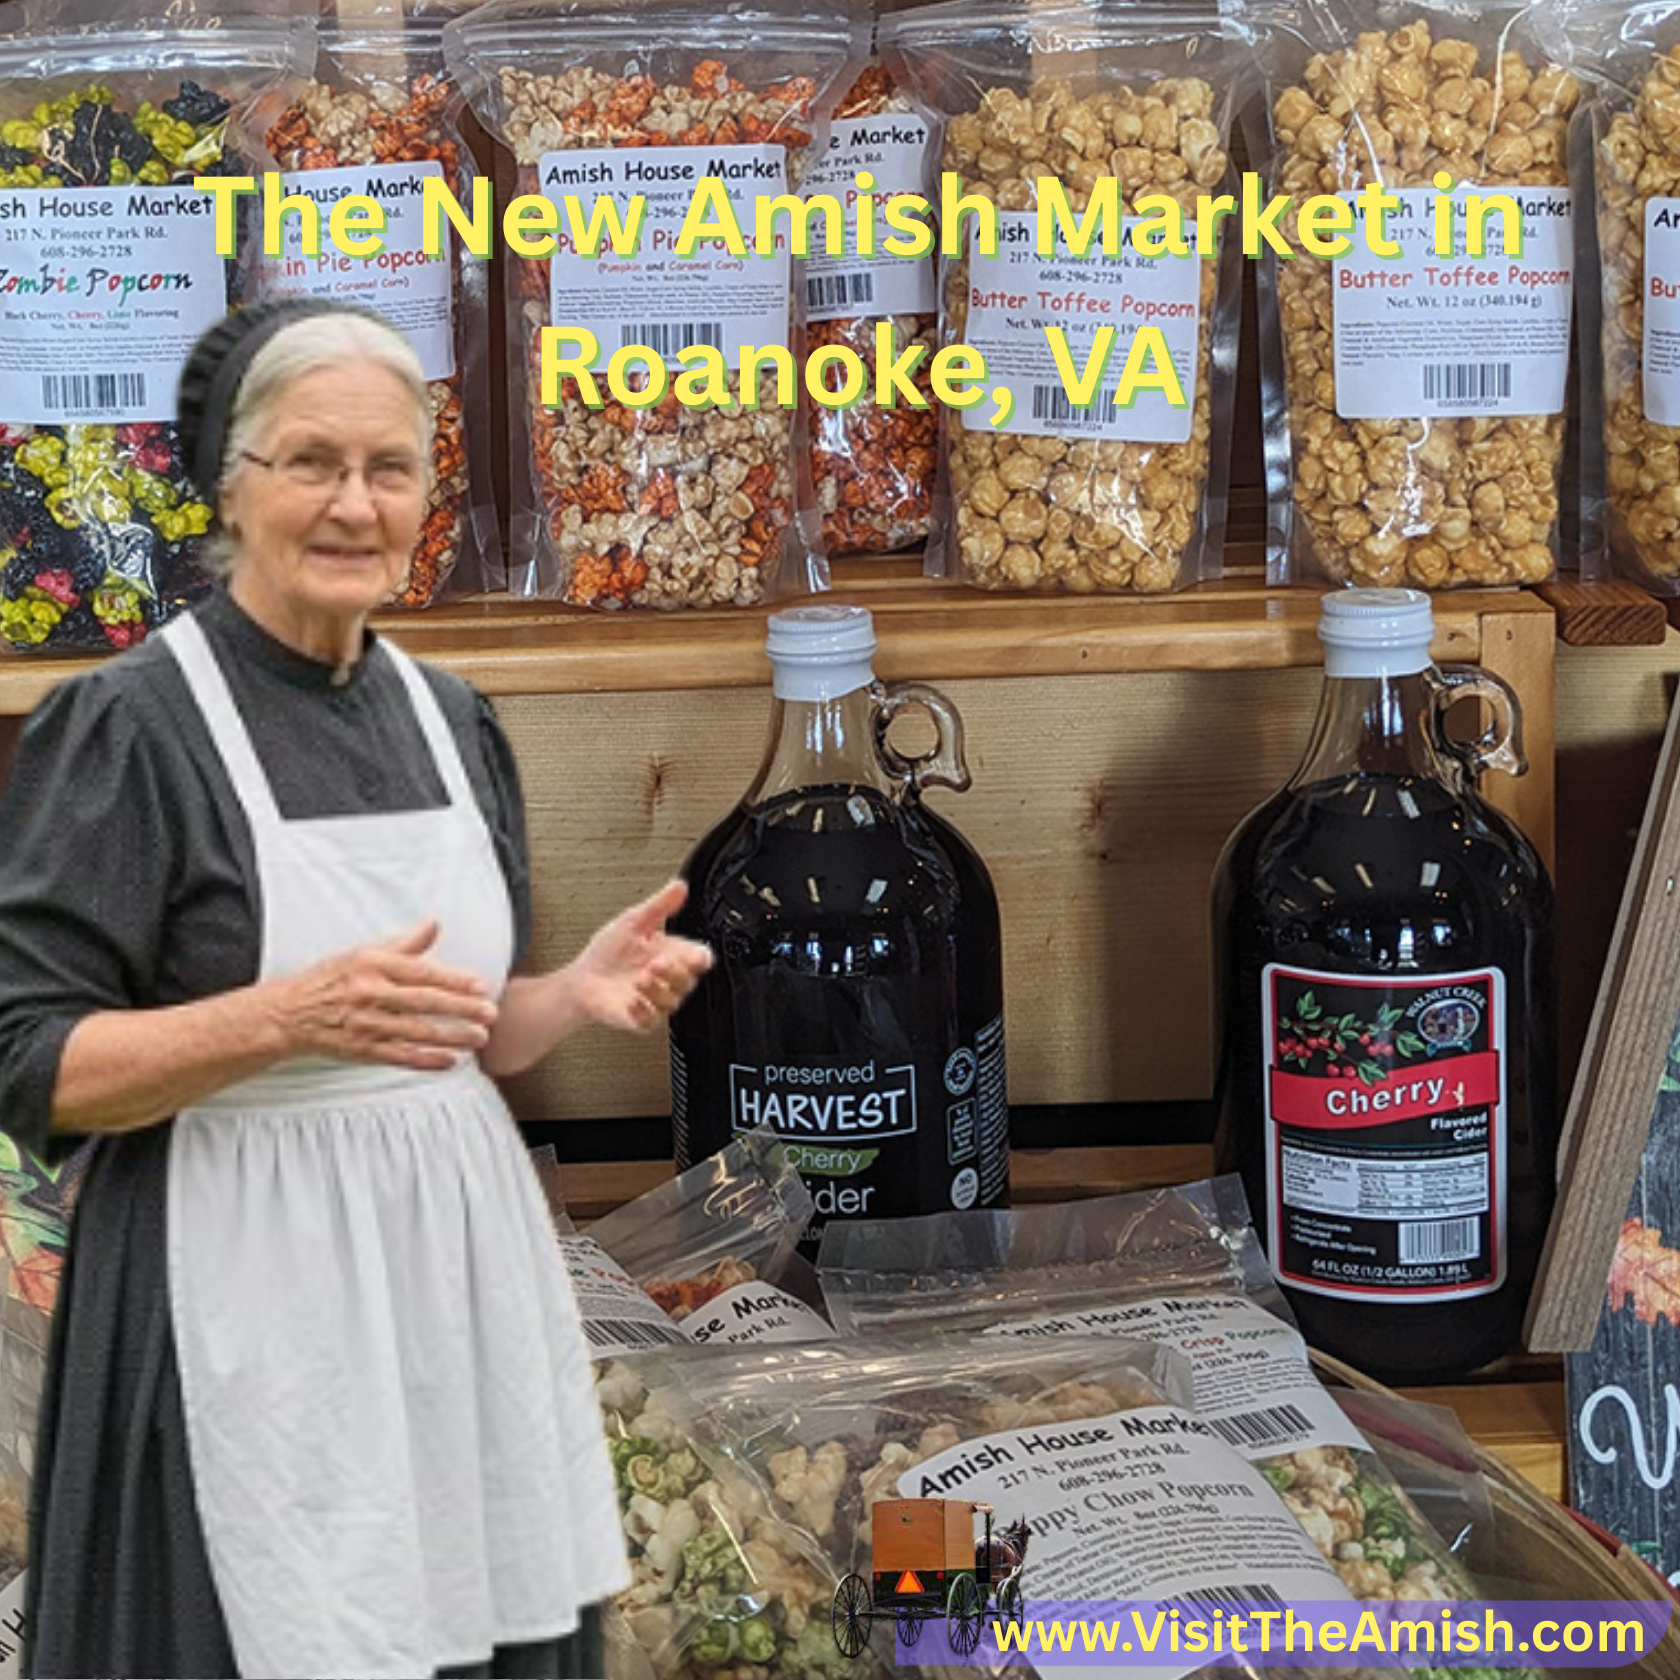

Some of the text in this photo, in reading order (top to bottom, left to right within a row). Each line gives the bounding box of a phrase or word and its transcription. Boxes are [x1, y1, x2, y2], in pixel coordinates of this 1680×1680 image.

[849, 124, 926, 147] Market
[545, 156, 782, 186] Amish House Market
[365, 173, 427, 199] Mark
[39, 197, 114, 218] House
[127, 193, 213, 217] Market
[5, 225, 169, 242] 217 N. Pioneer Park Rd.
[973, 221, 1031, 243] Aish
[1390, 228, 1414, 241] 217
[40, 245, 133, 259] 608-296-2728
[317, 248, 352, 274] Pie
[1008, 251, 1030, 264] 217
[1101, 254, 1132, 268] Park
[1135, 257, 1158, 270] Rd.
[645, 262, 665, 272] and
[1038, 271, 1124, 285] 608-296-2728
[1338, 265, 1571, 290] Butter Toffee Popcorn
[85, 267, 193, 308] Popcorn
[971, 287, 1195, 321] Butter Toffee Popcorn
[1386, 297, 1411, 309] Net.
[1414, 296, 1441, 308] Wt.
[1444, 296, 1460, 308] 12
[1462, 298, 1477, 307] oz
[1405, 985, 1487, 1017] WALNUT CREEK
[765, 1060, 876, 1086] preserved
[1325, 1077, 1445, 1116] Cherry
[740, 1088, 907, 1132] HARVEST
[1429, 1111, 1488, 1131] Flavored
[1452, 1125, 1488, 1141] Cider
[783, 1145, 863, 1174] Cherry
[805, 1181, 876, 1215] ider
[1342, 1262, 1360, 1275] OZ
[1360, 1266, 1384, 1277] (1/2
[1384, 1266, 1437, 1279] GALLON)
[1076, 1306, 1158, 1327] House
[918, 1443, 1015, 1499] Amish
[1016, 1427, 1115, 1456] House
[997, 1442, 1191, 1490] 217 N. Pioneer Park Rd.
[1058, 1462, 1167, 1492] 608-296-2728
[1082, 1486, 1155, 1514] Chow
[1157, 1479, 1255, 1511] Popcorn
